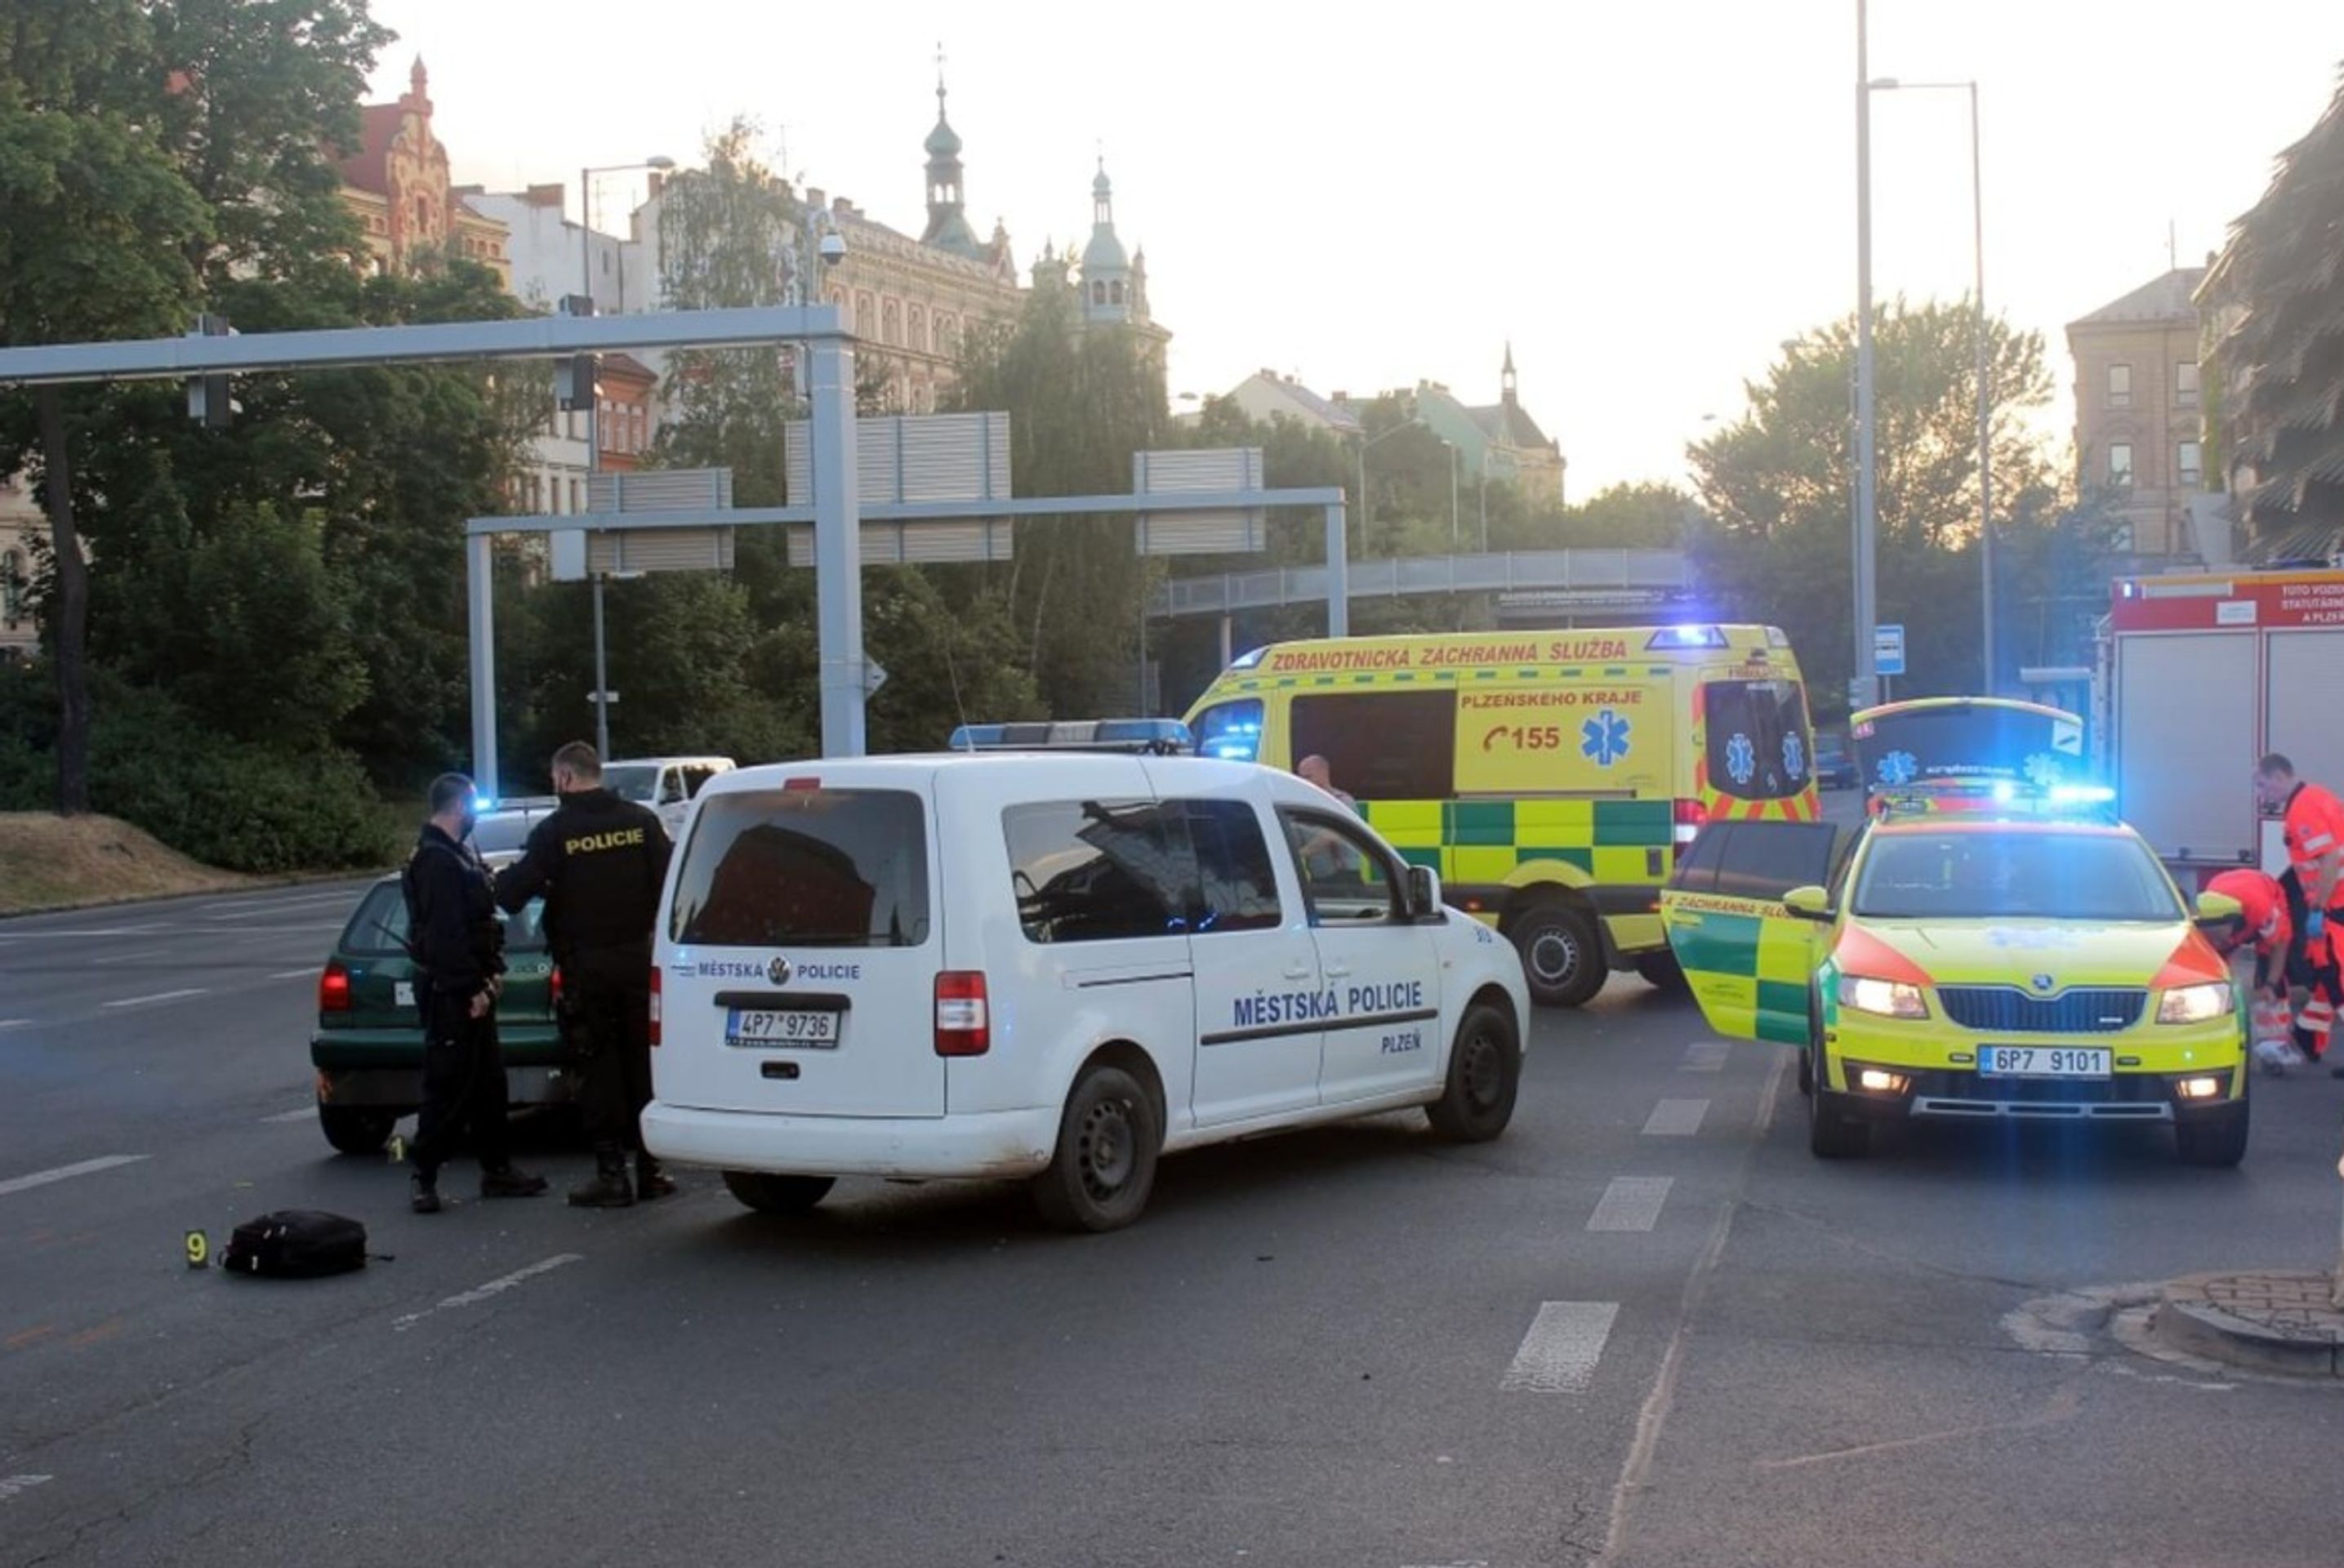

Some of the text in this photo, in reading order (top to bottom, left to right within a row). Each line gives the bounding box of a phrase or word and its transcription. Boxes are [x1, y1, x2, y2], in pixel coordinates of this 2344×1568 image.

[1549, 635, 1628, 661] SLUŽBA
[1581, 690, 1643, 705] KRAJE
[1511, 727, 1561, 750] 155
[565, 827, 644, 855] POLICIE
[797, 964, 861, 979] POLICIE
[1234, 982, 1422, 1027] MĚSTSKÁ POLICIE
[742, 1013, 829, 1036] 4P7 9736
[1382, 1028, 1421, 1054] PLZEŇ
[1996, 1049, 2101, 1071] 6P7 9101
[186, 1232, 205, 1263] 9
